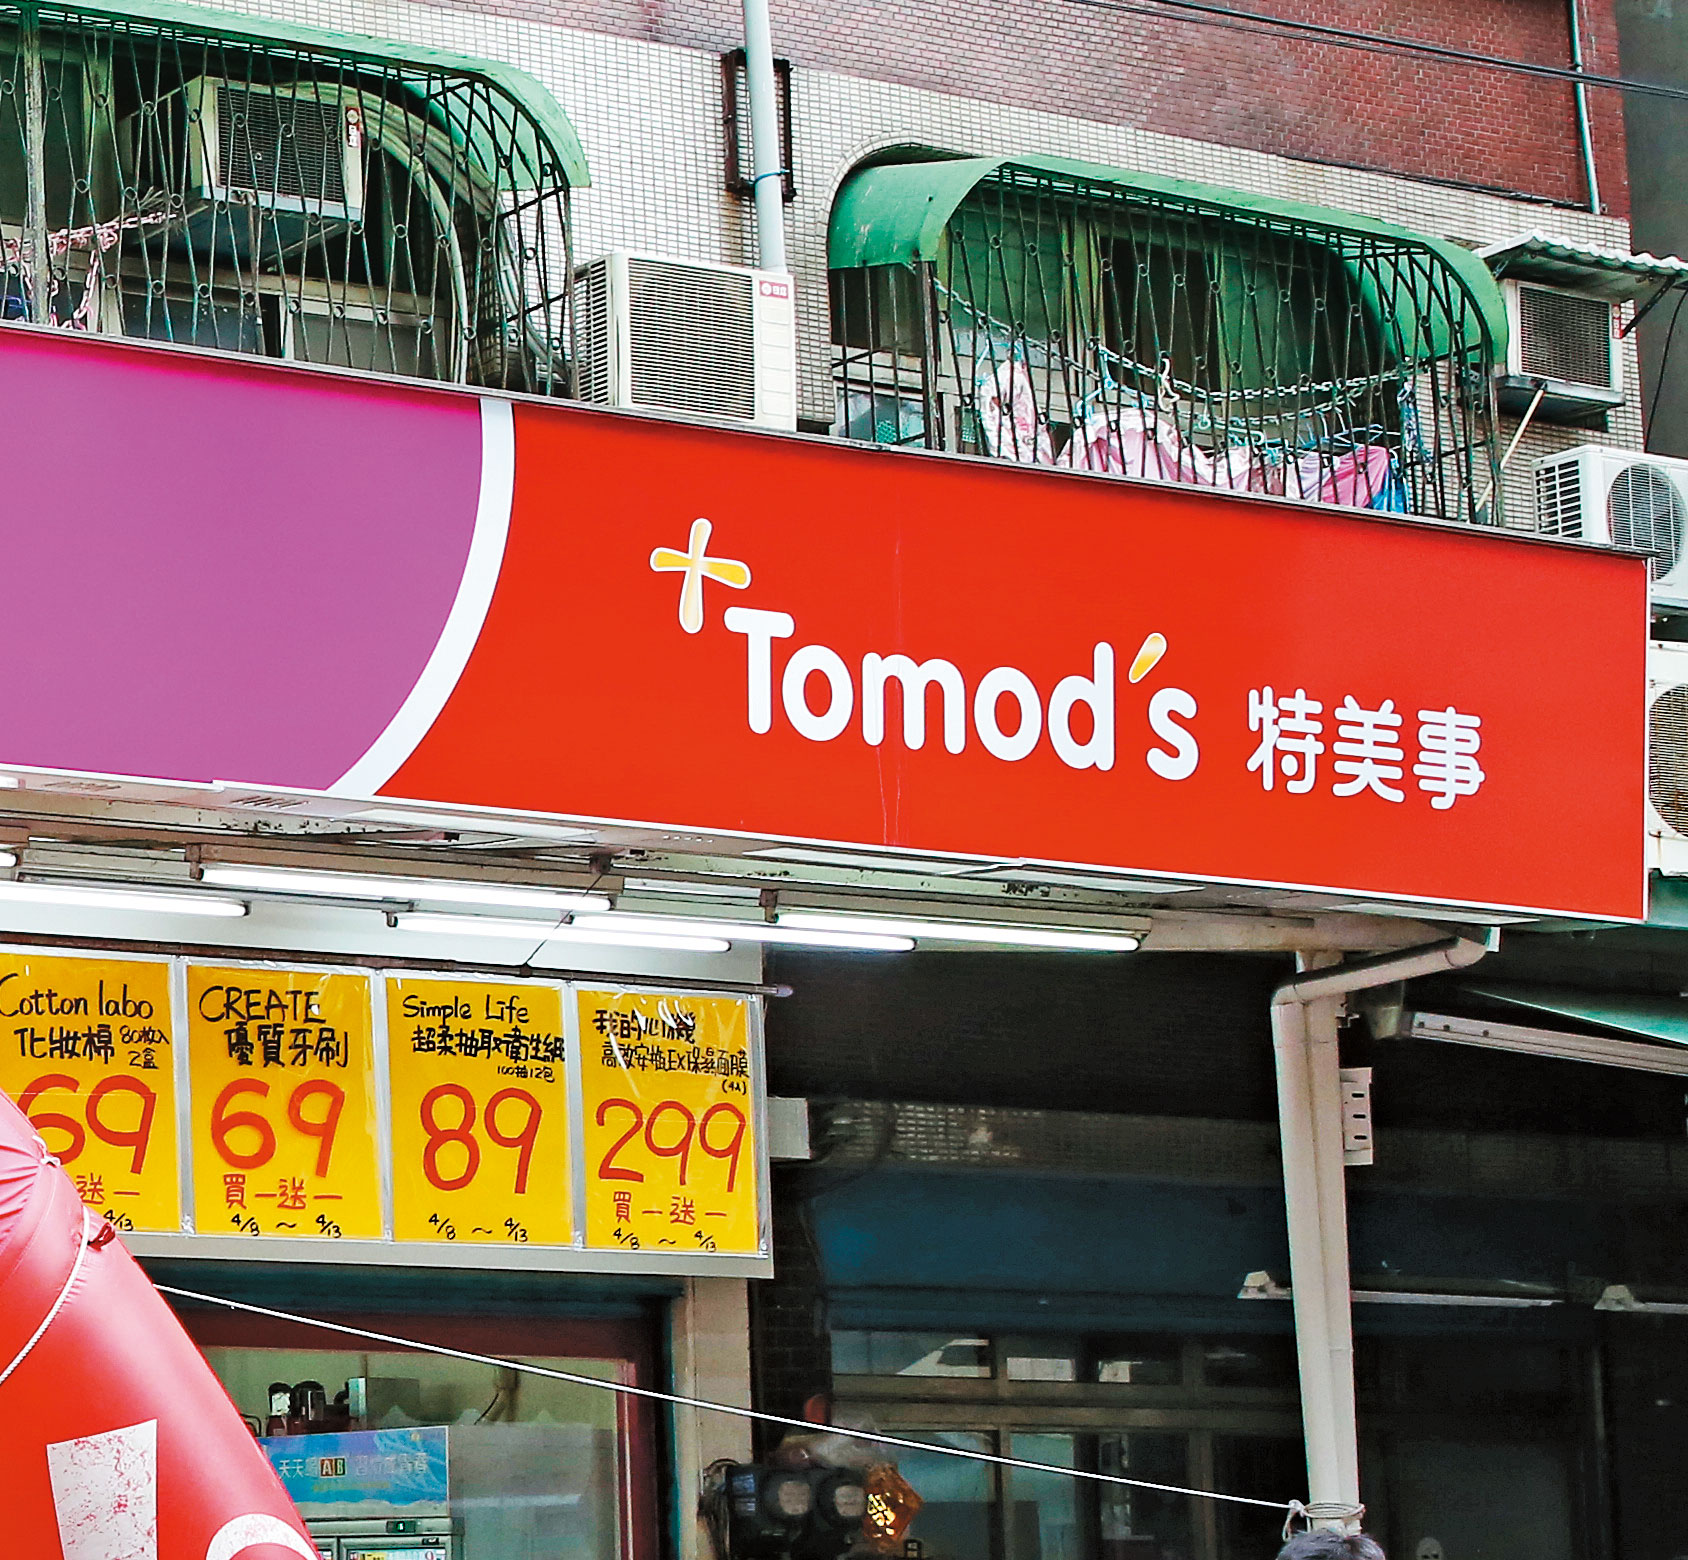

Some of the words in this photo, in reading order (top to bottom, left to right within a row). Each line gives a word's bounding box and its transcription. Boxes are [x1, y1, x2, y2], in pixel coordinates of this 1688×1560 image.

[724, 606, 1200, 781] Tomod's
[1246, 684, 1487, 811] 特美事
[97, 979, 154, 1020] labo
[198, 984, 328, 1024] CREATE
[402, 994, 473, 1026] Simple
[484, 993, 530, 1024] Life
[223, 1022, 350, 1068] 優質牙刷
[17, 1073, 158, 1175] 69
[210, 1077, 346, 1178] 69
[420, 1083, 543, 1195] 89
[596, 1098, 746, 1193] 299
[222, 1173, 344, 1210] 買一送一
[612, 1191, 728, 1226] 買一送一
[315, 1213, 343, 1239] 4/13
[503, 1215, 529, 1243] 4/13
[693, 1229, 717, 1253] 4/13
